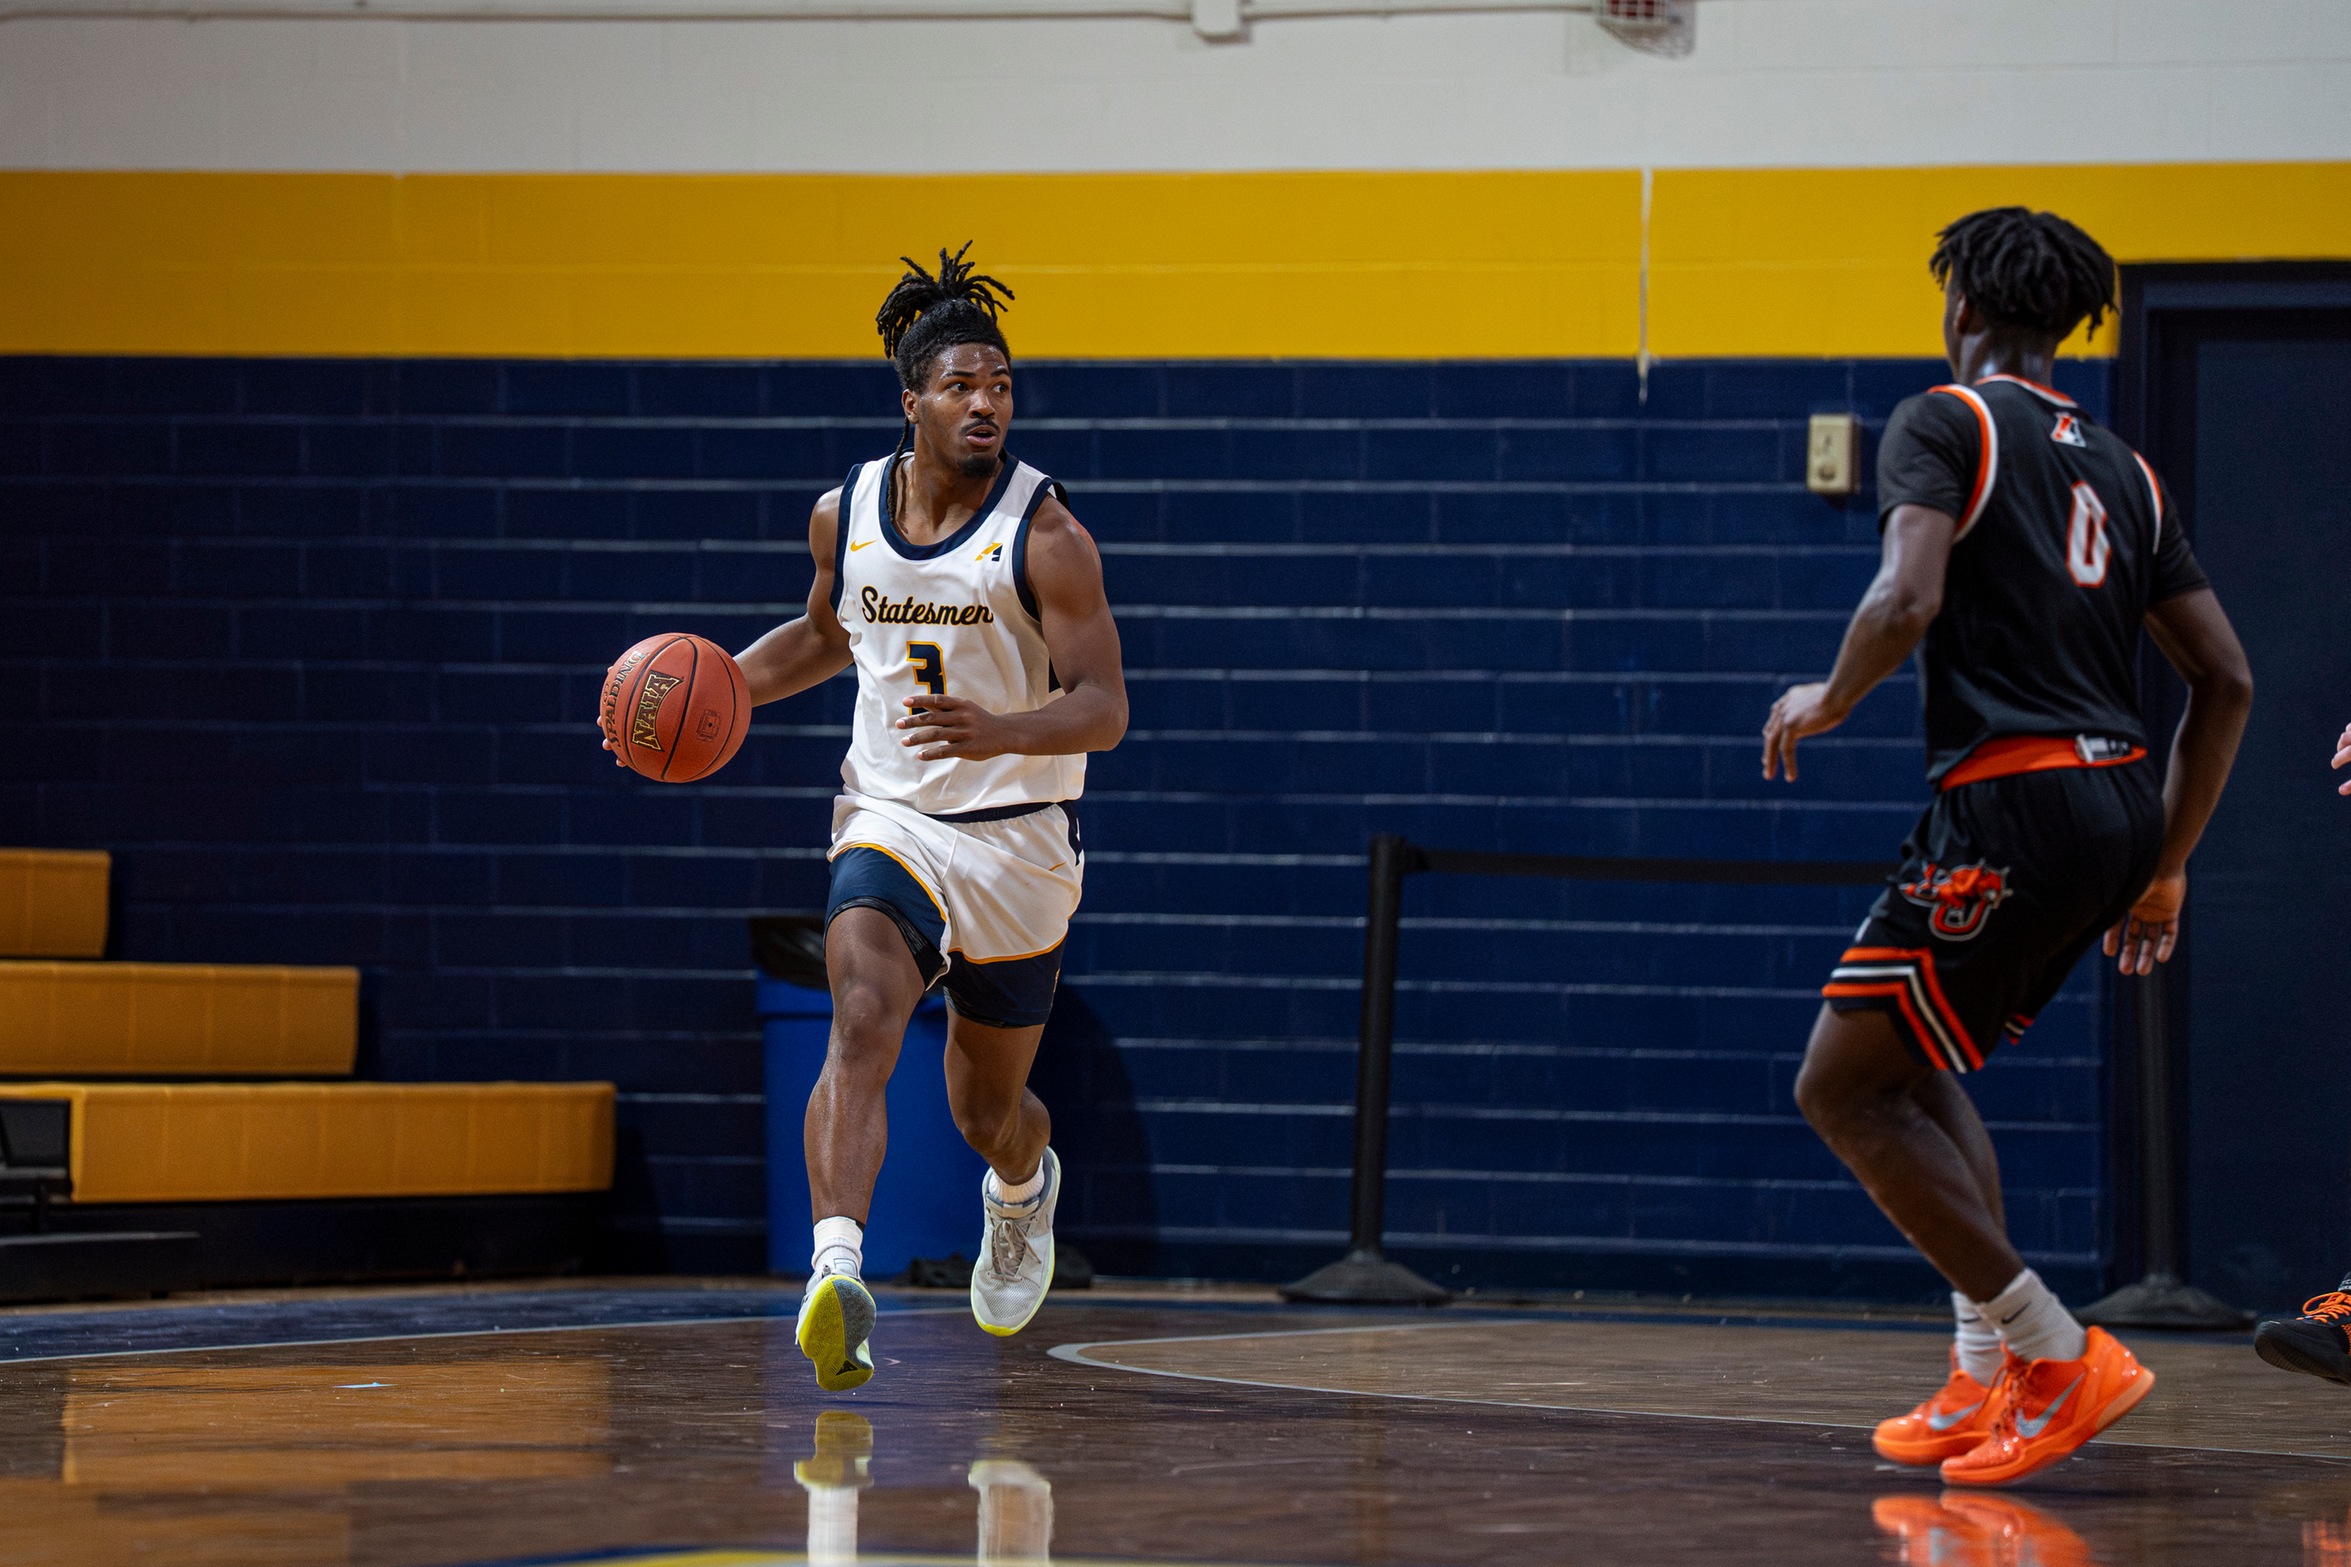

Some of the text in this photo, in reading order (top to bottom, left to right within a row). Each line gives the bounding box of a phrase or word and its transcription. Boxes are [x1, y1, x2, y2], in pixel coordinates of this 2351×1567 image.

[2065, 480, 2111, 588] 0
[861, 585, 994, 626] Statesmen
[606, 650, 646, 748] SPALDING
[631, 673, 682, 751] NAIA
[905, 640, 948, 716] 3
